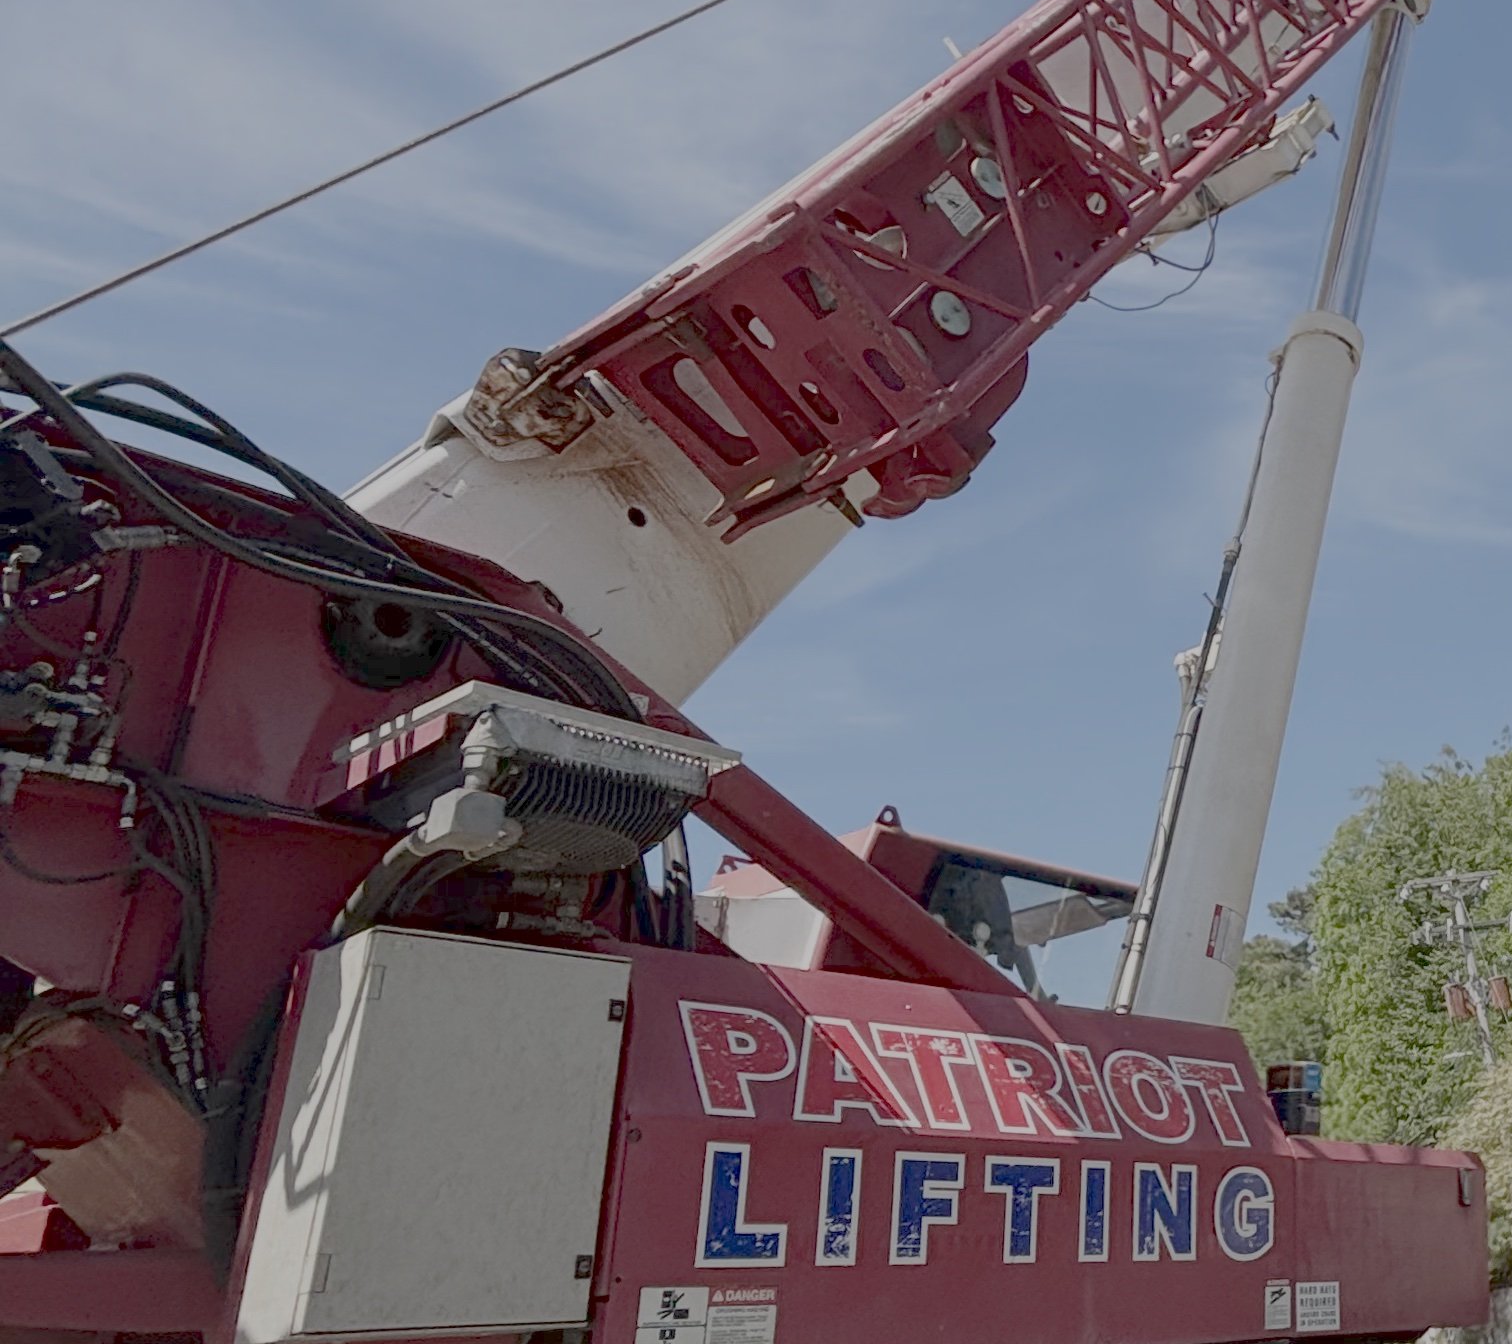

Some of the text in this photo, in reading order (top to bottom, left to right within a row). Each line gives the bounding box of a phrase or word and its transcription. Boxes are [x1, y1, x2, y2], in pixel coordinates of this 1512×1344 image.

[679, 999, 1251, 1147] PATRIOT
[695, 1141, 1275, 1268] LIFTING
[725, 1289, 775, 1302] DANGER
[1300, 1296, 1337, 1308] REQUIRED
